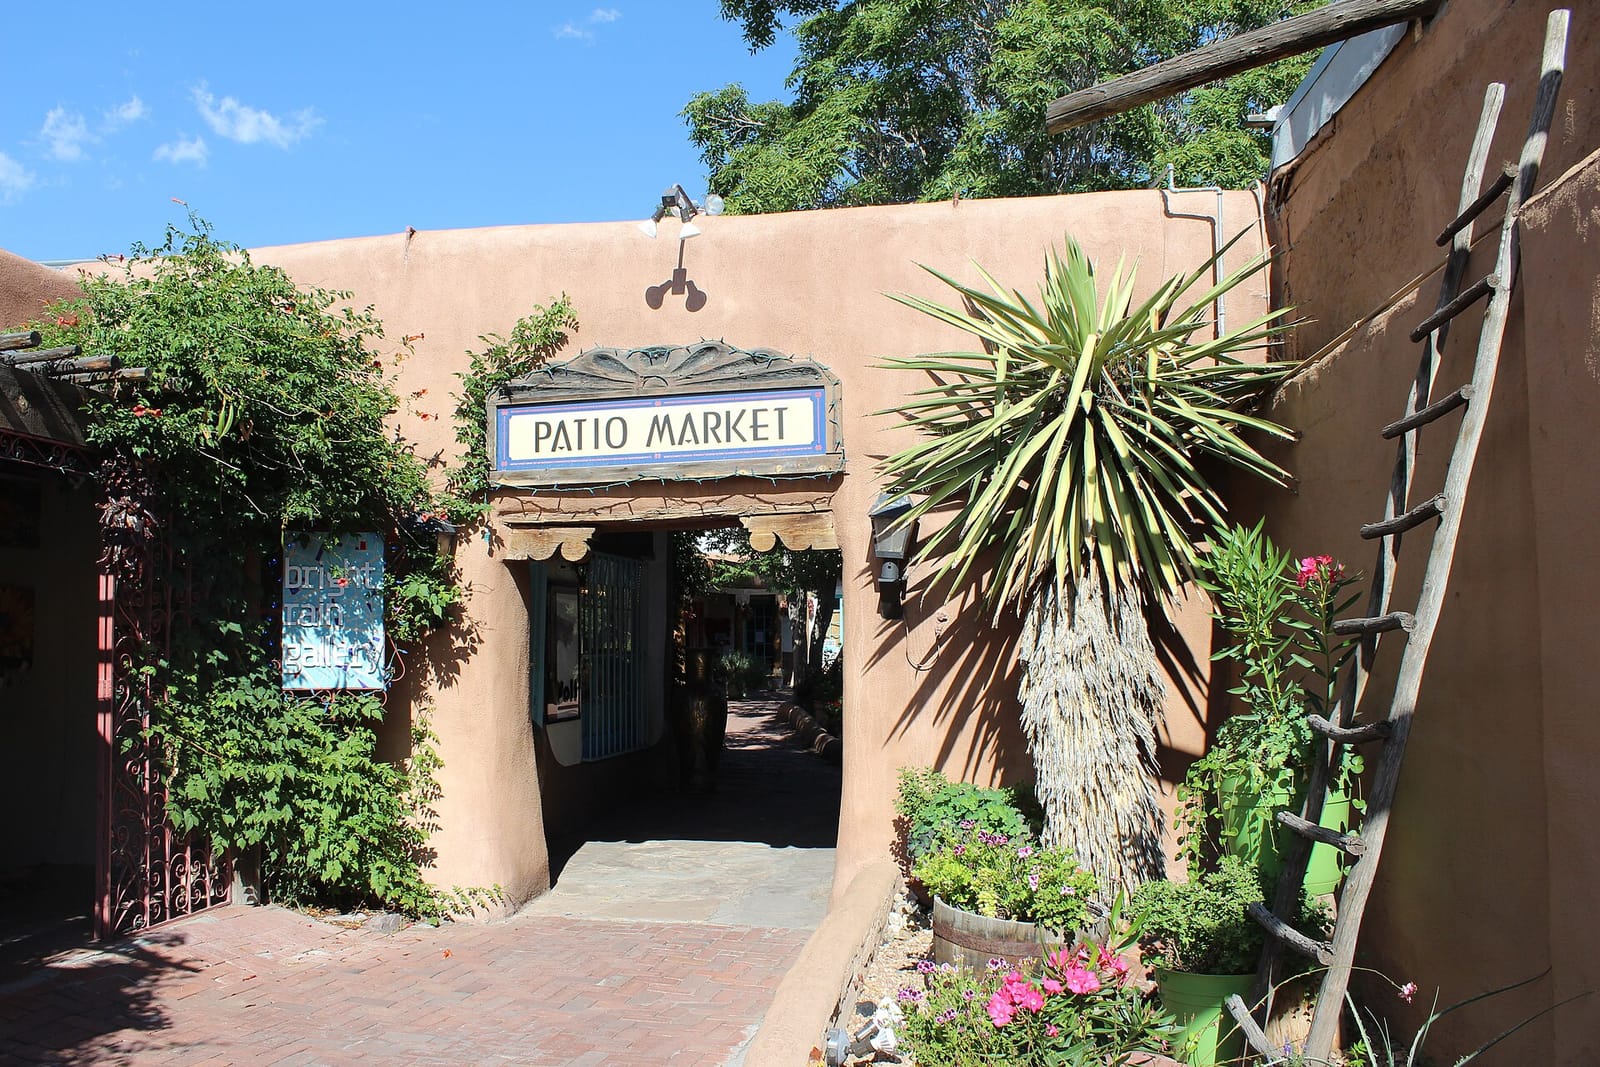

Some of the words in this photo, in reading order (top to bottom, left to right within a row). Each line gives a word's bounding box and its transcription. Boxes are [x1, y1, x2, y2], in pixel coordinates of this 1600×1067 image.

[535, 416, 628, 453] PATIO
[646, 407, 788, 447] MARKET
[285, 557, 379, 597] bright
[284, 599, 344, 627] rain
[286, 635, 380, 675] gallery
